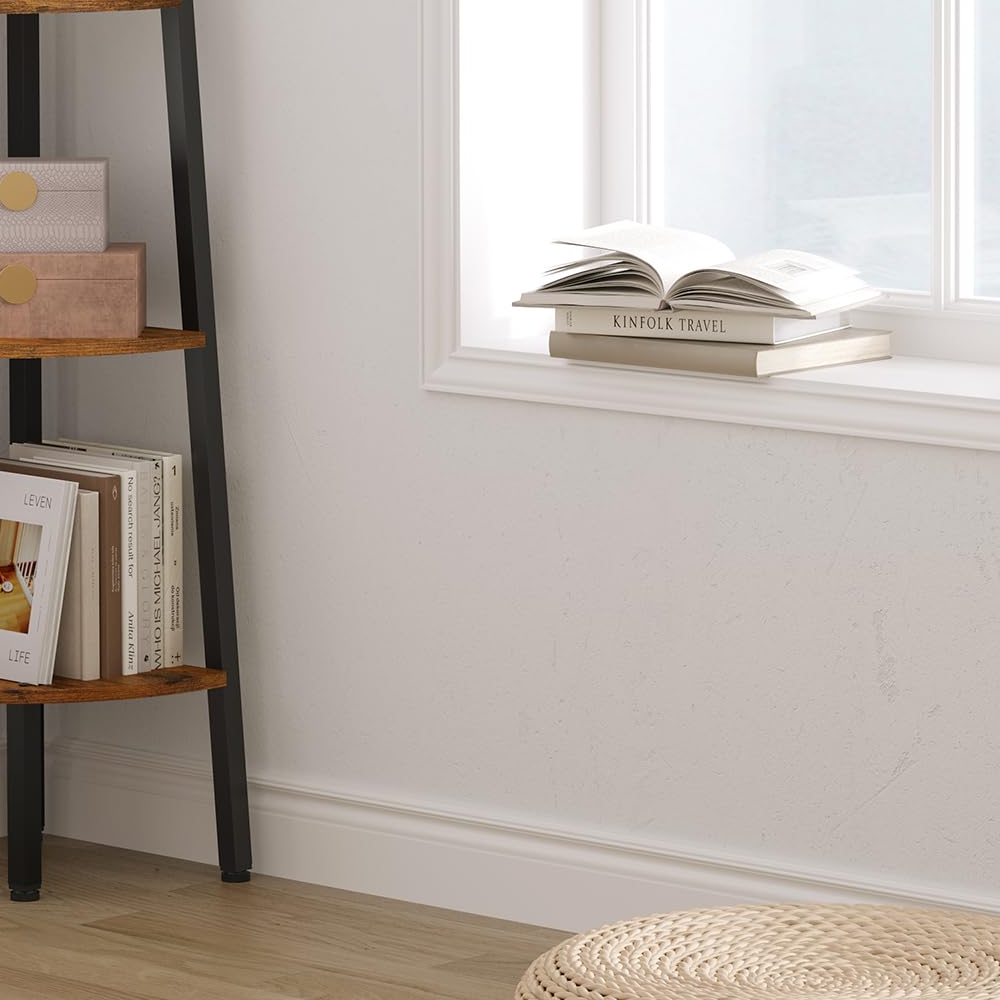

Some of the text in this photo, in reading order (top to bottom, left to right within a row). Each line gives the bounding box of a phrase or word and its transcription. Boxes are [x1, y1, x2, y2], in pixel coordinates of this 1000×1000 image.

[613, 315, 726, 333] KINFOLK TRAVEL
[128, 476, 134, 492] No
[23, 494, 52, 509] LEVEN
[154, 608, 161, 623] IS
[154, 627, 162, 670] WHO
[8, 649, 31, 664] LIFE
